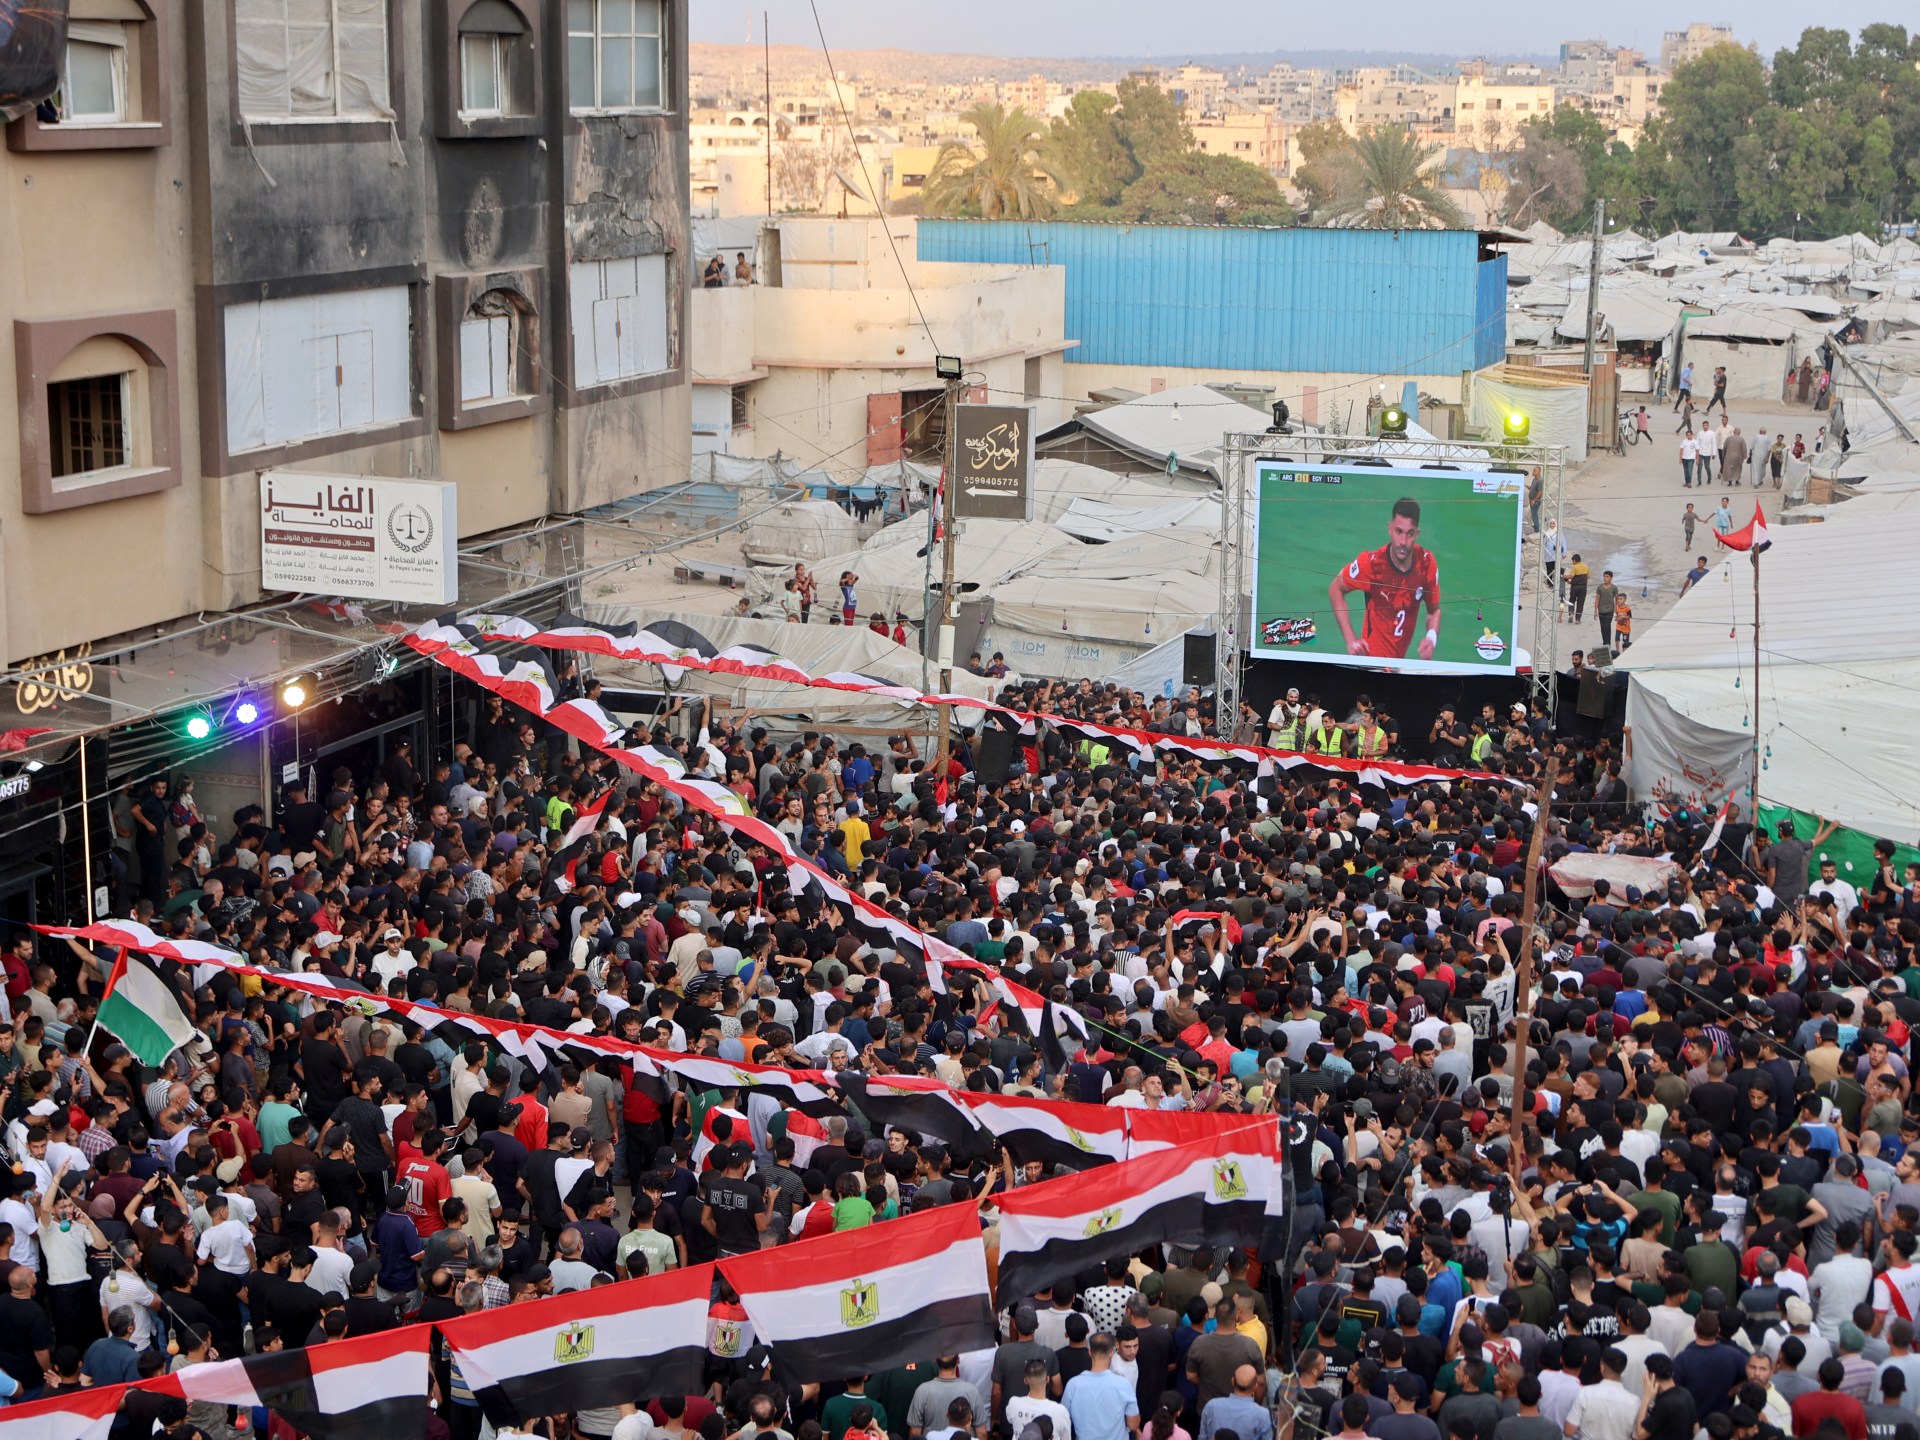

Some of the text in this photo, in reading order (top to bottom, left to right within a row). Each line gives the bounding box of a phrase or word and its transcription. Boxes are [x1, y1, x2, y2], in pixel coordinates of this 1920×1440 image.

[963, 476, 1019, 487] 0599405775
[264, 480, 374, 517] الفايز
[272, 508, 373, 530] للمحاماة
[274, 572, 317, 583] 0599222582
[331, 577, 375, 588] 0566373706
[1393, 609, 1406, 637] 2
[1022, 641, 1046, 652] IOM
[1077, 646, 1100, 658] IOM
[0, 777, 30, 799] 05775
[1495, 989, 1508, 1012] 7
[661, 1190, 677, 1198] adidas
[712, 1191, 745, 1208] NYC
[639, 1244, 659, 1255] Free
